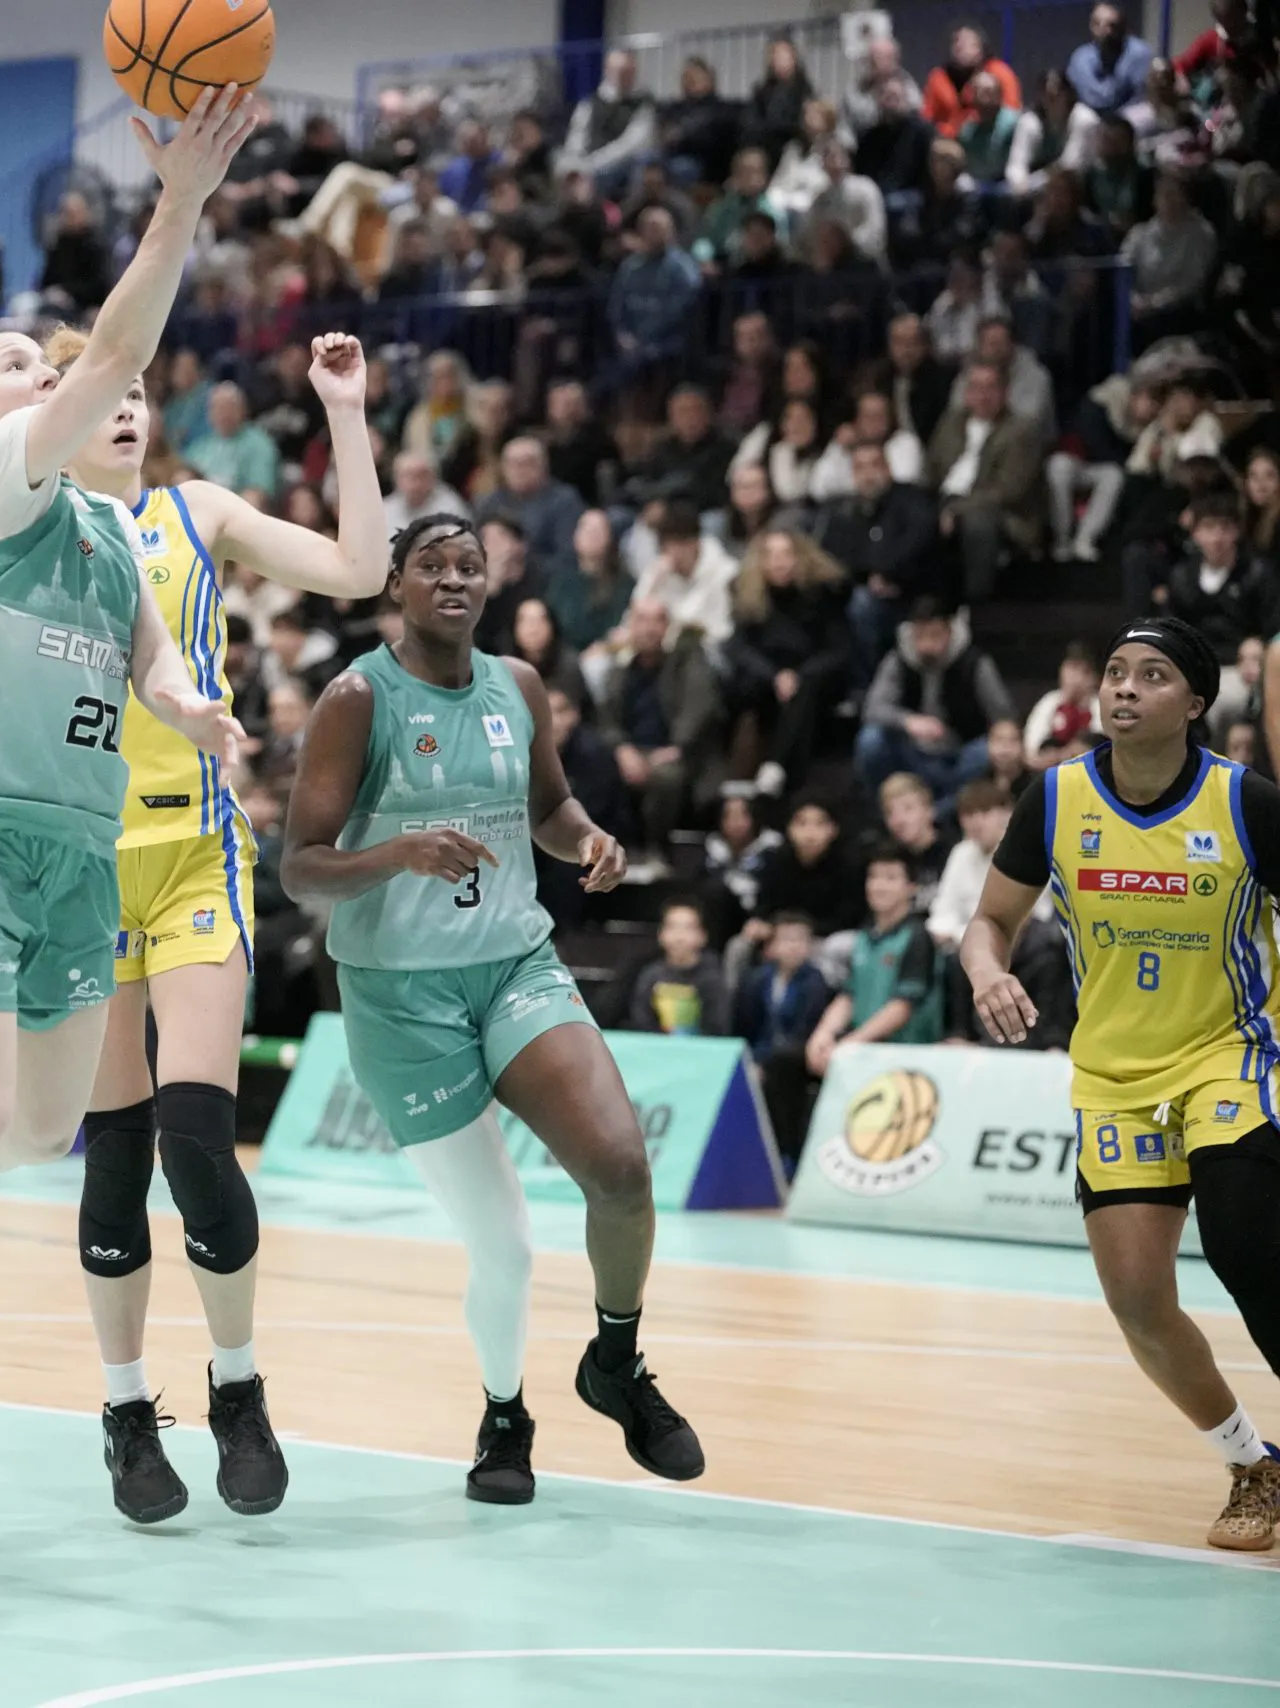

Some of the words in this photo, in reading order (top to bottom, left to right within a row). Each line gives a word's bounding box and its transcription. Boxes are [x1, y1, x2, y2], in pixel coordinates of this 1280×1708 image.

[37, 624, 113, 672] SGM
[453, 865, 483, 911] 3
[1099, 872, 1187, 892] SPAR
[1099, 893, 1131, 901] GRAN
[1132, 893, 1186, 904] CANARIA
[1117, 927, 1151, 940] Gran
[1151, 928, 1210, 943] Canaria
[1136, 951, 1161, 992] 8
[1096, 1123, 1122, 1164] 8
